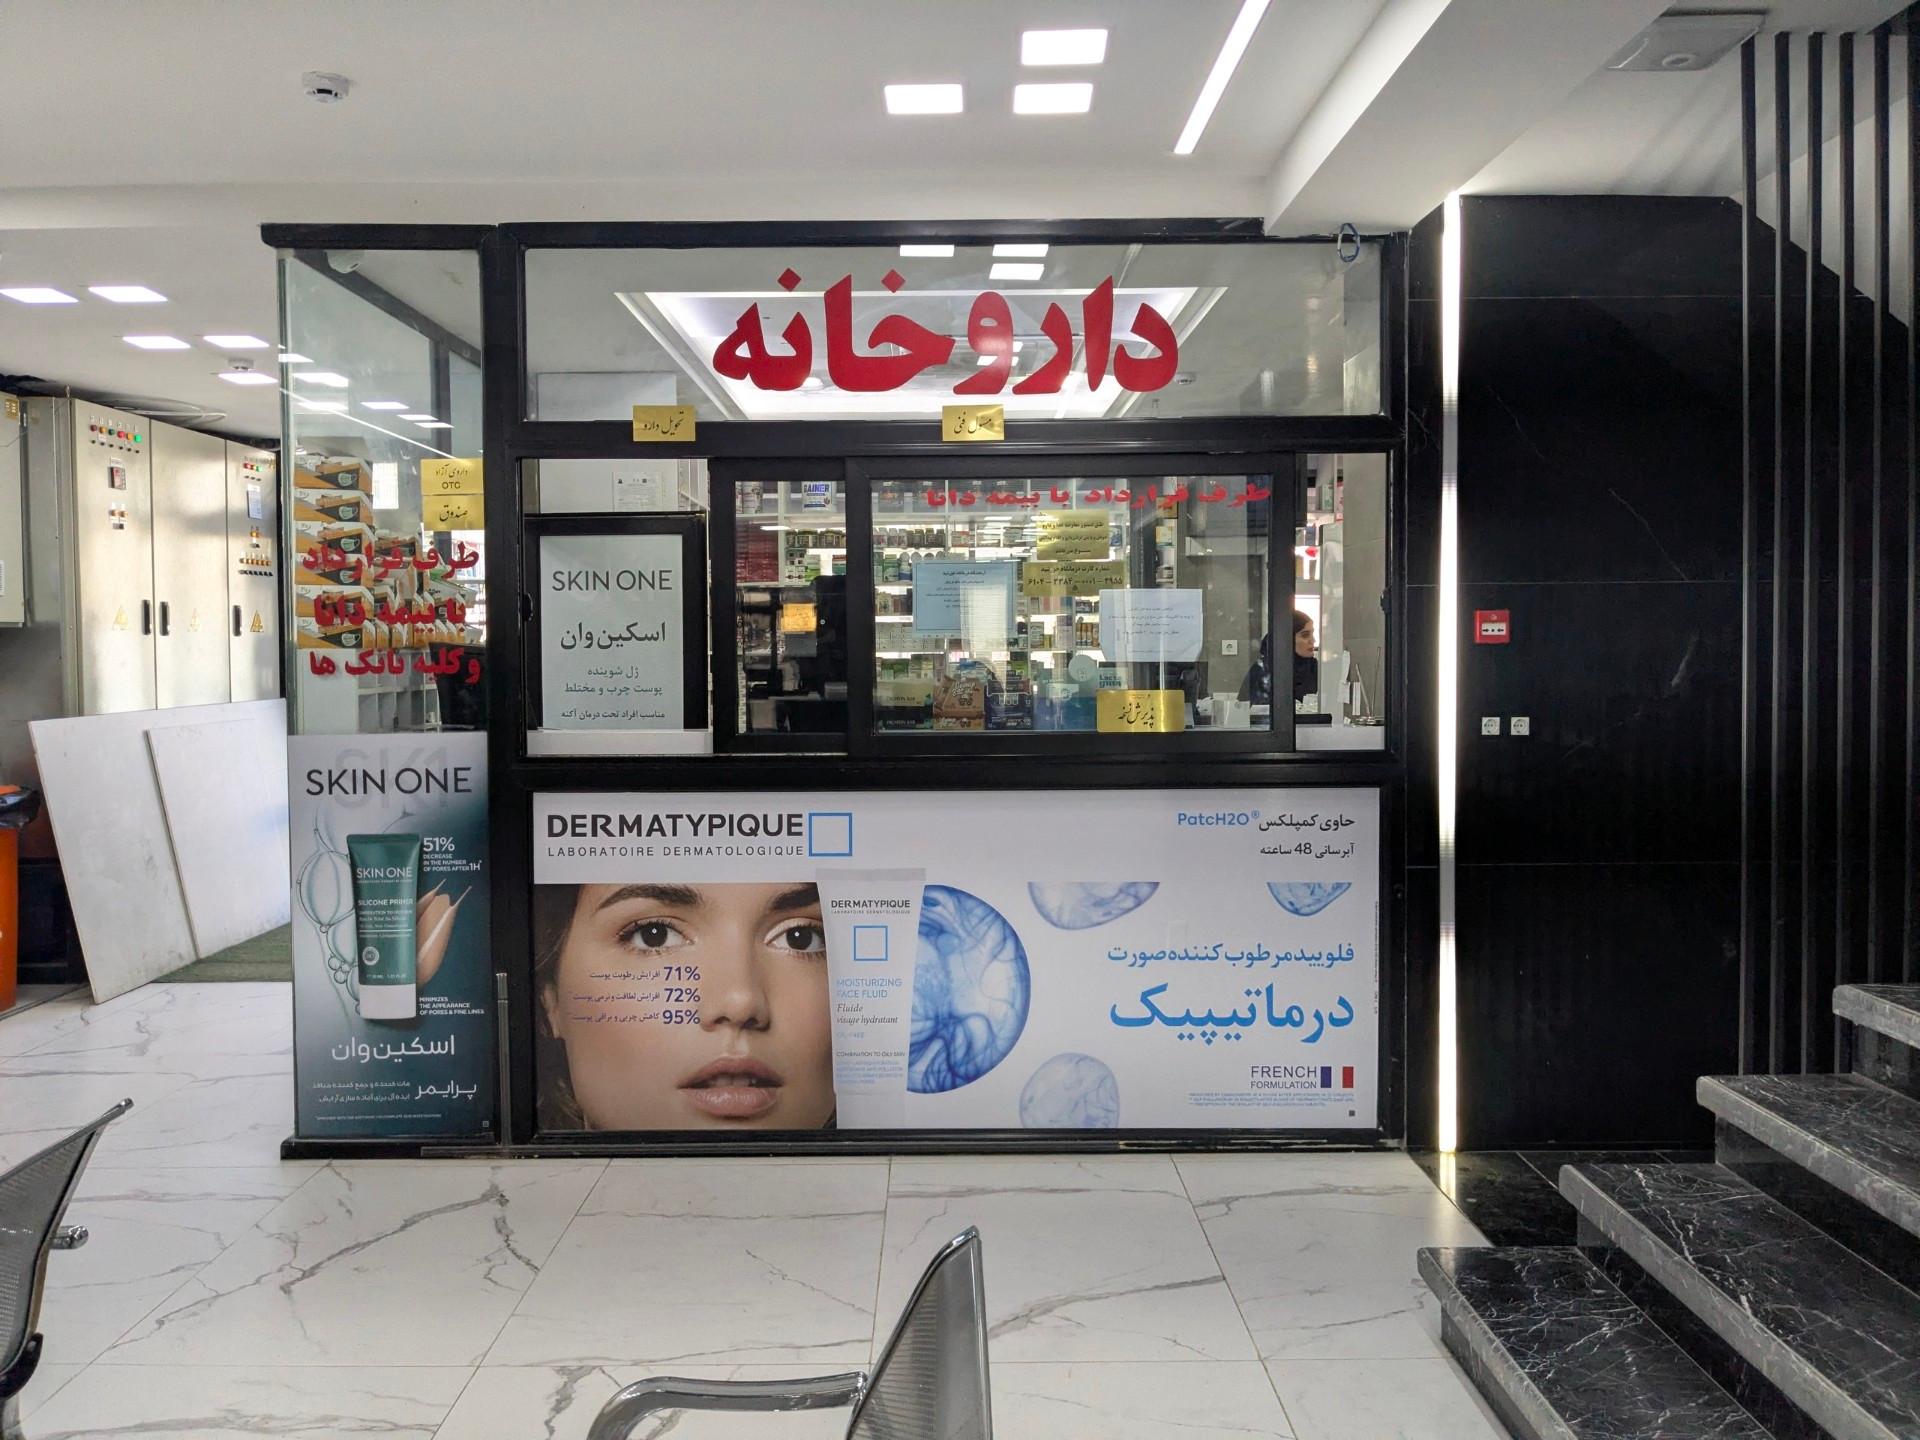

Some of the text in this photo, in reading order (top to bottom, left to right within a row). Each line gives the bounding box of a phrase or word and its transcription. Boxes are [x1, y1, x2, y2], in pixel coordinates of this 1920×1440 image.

[712, 267, 1179, 395] داروخانه
[643, 410, 685, 436] تحویل دارو
[953, 410, 966, 434] فنی
[435, 463, 468, 478] داروی آزاد
[985, 487, 1041, 508] بیمه
[1050, 486, 1070, 507] با
[439, 504, 468, 522] صندوق
[413, 541, 479, 579] طرف
[552, 569, 673, 591] SKIN ONE
[377, 600, 435, 632] بیمه
[447, 598, 466, 632] با
[560, 621, 666, 650] اسکین وان
[310, 652, 336, 675] ها
[346, 648, 404, 675] بانک
[587, 665, 639, 678] ژل شوینده
[564, 682, 596, 693] مختلط
[606, 684, 630, 696] چرب
[633, 684, 663, 695] پوست
[561, 708, 665, 720] مناسب افراد تحت درمان آکنه
[1117, 702, 1154, 728] پذیرش نسخه
[306, 767, 473, 796] SKIN ONE
[547, 813, 804, 838] DERMATYPIQUE
[1258, 813, 1355, 832] حاوی کمپلکس
[423, 837, 455, 851] 51%
[548, 845, 804, 857] LABORATOIRE DERMATOLOGIQUE
[1260, 842, 1355, 858] آبرسانی 48 ساعته
[356, 867, 412, 878] SKIN ONE
[831, 899, 911, 908] DERMATYPIQUE
[1107, 946, 1168, 968] صورت
[663, 966, 701, 981] 71%
[836, 978, 903, 987] MOISTURIZING
[663, 988, 701, 1002] 72%
[836, 989, 888, 998] FACE FLUID
[837, 1003, 863, 1013] Fluide
[1110, 982, 1354, 1046] درماتیپیک
[663, 1010, 701, 1025] 95%
[837, 1014, 899, 1026] visage hydratant
[331, 1034, 455, 1064] اسکین وان
[1251, 1066, 1317, 1078] FRENCH
[414, 1080, 477, 1100] پرایمر
[1250, 1081, 1317, 1090] FORMULATION
